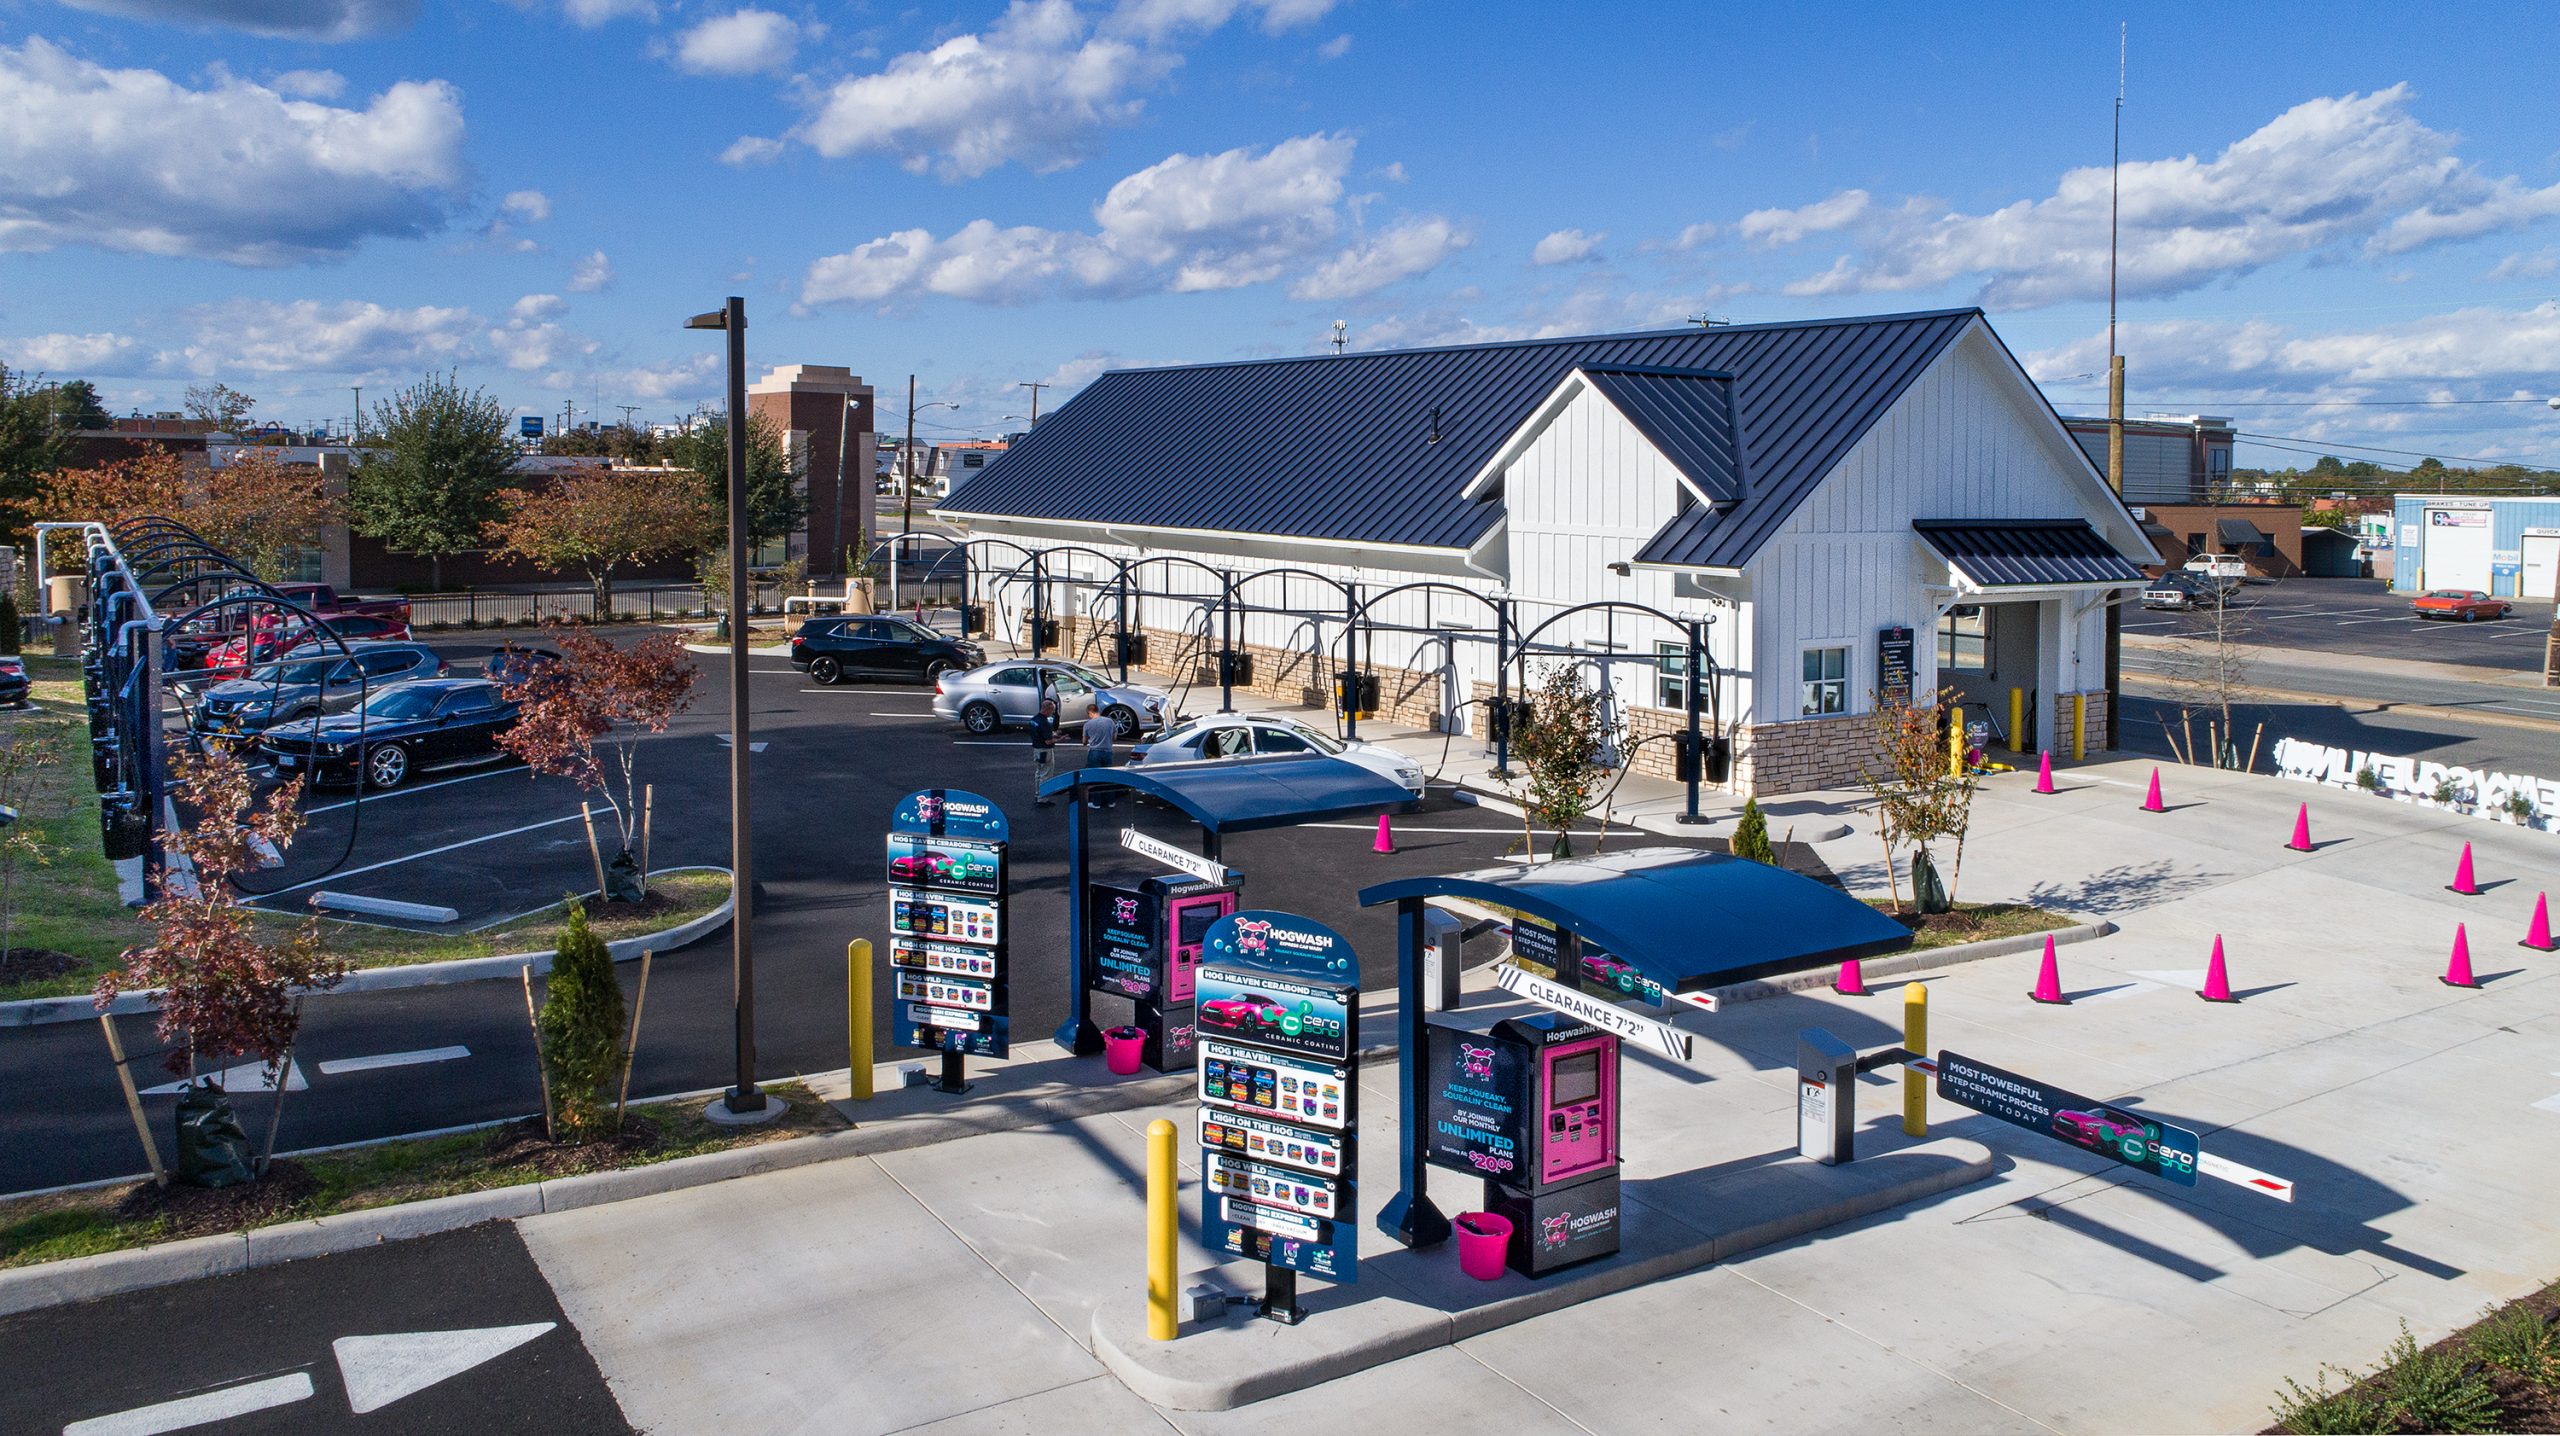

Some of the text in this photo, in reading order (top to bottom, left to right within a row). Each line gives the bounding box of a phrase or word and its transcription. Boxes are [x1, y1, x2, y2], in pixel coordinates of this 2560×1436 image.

[2493, 553, 2519, 561] Mobil
[943, 803, 988, 814] HOGWASH
[937, 840, 971, 849] CERABOND
[1138, 840, 1184, 867] CLEARANCE
[915, 892, 944, 900] HEAVEN
[1270, 929, 1332, 947] HOGWASH
[1519, 926, 1537, 938] MOST
[945, 945, 960, 953] HOG
[1518, 936, 1531, 945] STEP
[1531, 941, 1554, 954] CERAMIC
[1120, 949, 1138, 958] JOINING
[1120, 954, 1142, 963] MONTHLY
[1100, 957, 1151, 976] UNLIMITED
[924, 975, 941, 983] WILD
[1134, 974, 1150, 983] PLANS
[1205, 970, 1310, 994] HOG HEAVEN CERABOND
[1529, 982, 1612, 1026] CLEARANCE
[1265, 1033, 1340, 1051] CERAMIC COATING
[1211, 1044, 1271, 1062] HOG HEAVEN
[1448, 1083, 1468, 1094] KEEP
[1949, 1062, 2042, 1101] MOST POWERFUL
[1942, 1072, 2049, 1116] 1 STEP CERAMIC PROCESS
[1483, 1101, 1512, 1114] CLEAN!
[1954, 1088, 2037, 1123] TRY IT TODAY
[1213, 1112, 1294, 1137] HIGH ON THE HOG
[1452, 1115, 1501, 1132] OUR MONTHLY
[1457, 1109, 1495, 1125] BY JOINING
[1437, 1119, 1514, 1150] UNLIMITED
[1441, 1145, 1460, 1156] Starting
[1489, 1146, 1514, 1159] PLANS
[1220, 1157, 1267, 1175] HOG WILD
[1232, 1202, 1270, 1217] HOGWASH
[1570, 1207, 1617, 1229] HOGWASH
